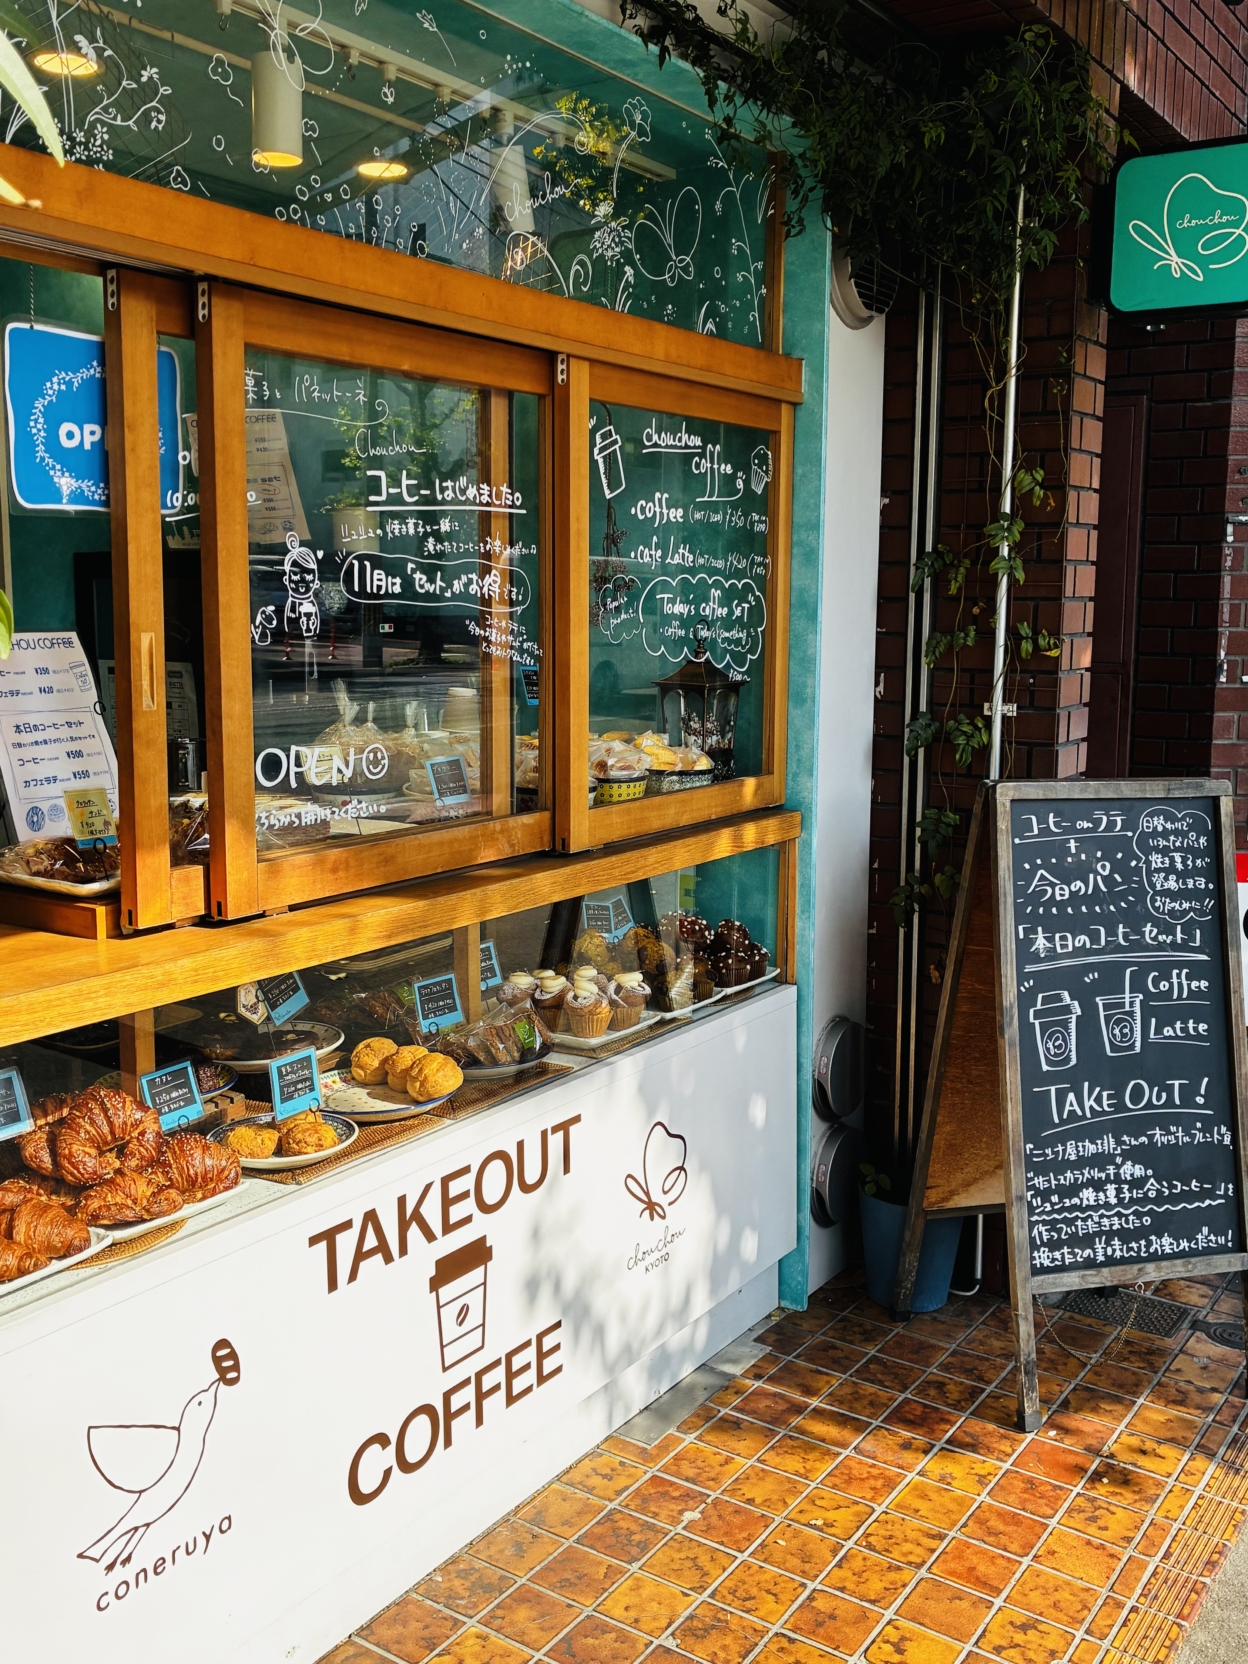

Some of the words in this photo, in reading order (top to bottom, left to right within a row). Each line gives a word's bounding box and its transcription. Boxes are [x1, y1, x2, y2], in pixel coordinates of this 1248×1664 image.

[504, 172, 581, 222] chouchou
[1176, 210, 1239, 228] chouchou
[59, 422, 103, 450] OP
[643, 418, 702, 447] chouchou
[656, 594, 695, 618] Today's
[700, 588, 728, 620] coffee
[34, 667, 50, 675] ¥350
[38, 686, 54, 695] ¥420
[13, 720, 84, 735] 本日のコーヒーセット
[17, 757, 45, 767] コーヒー
[65, 750, 84, 759] ¥500
[256, 745, 354, 788] OPEN
[23, 775, 58, 788] カフェラテ
[72, 770, 90, 780] ¥550
[1148, 969, 1209, 999] Coffee
[1150, 1018, 1208, 1038] Latte
[1033, 1081, 1117, 1123] TAKE
[308, 1113, 582, 1294] TAKEOUT
[627, 1226, 686, 1271] chouchou
[644, 1252, 670, 1275] KYOTO
[348, 1319, 563, 1506] COFFEE
[96, 1514, 232, 1612] coneruya
